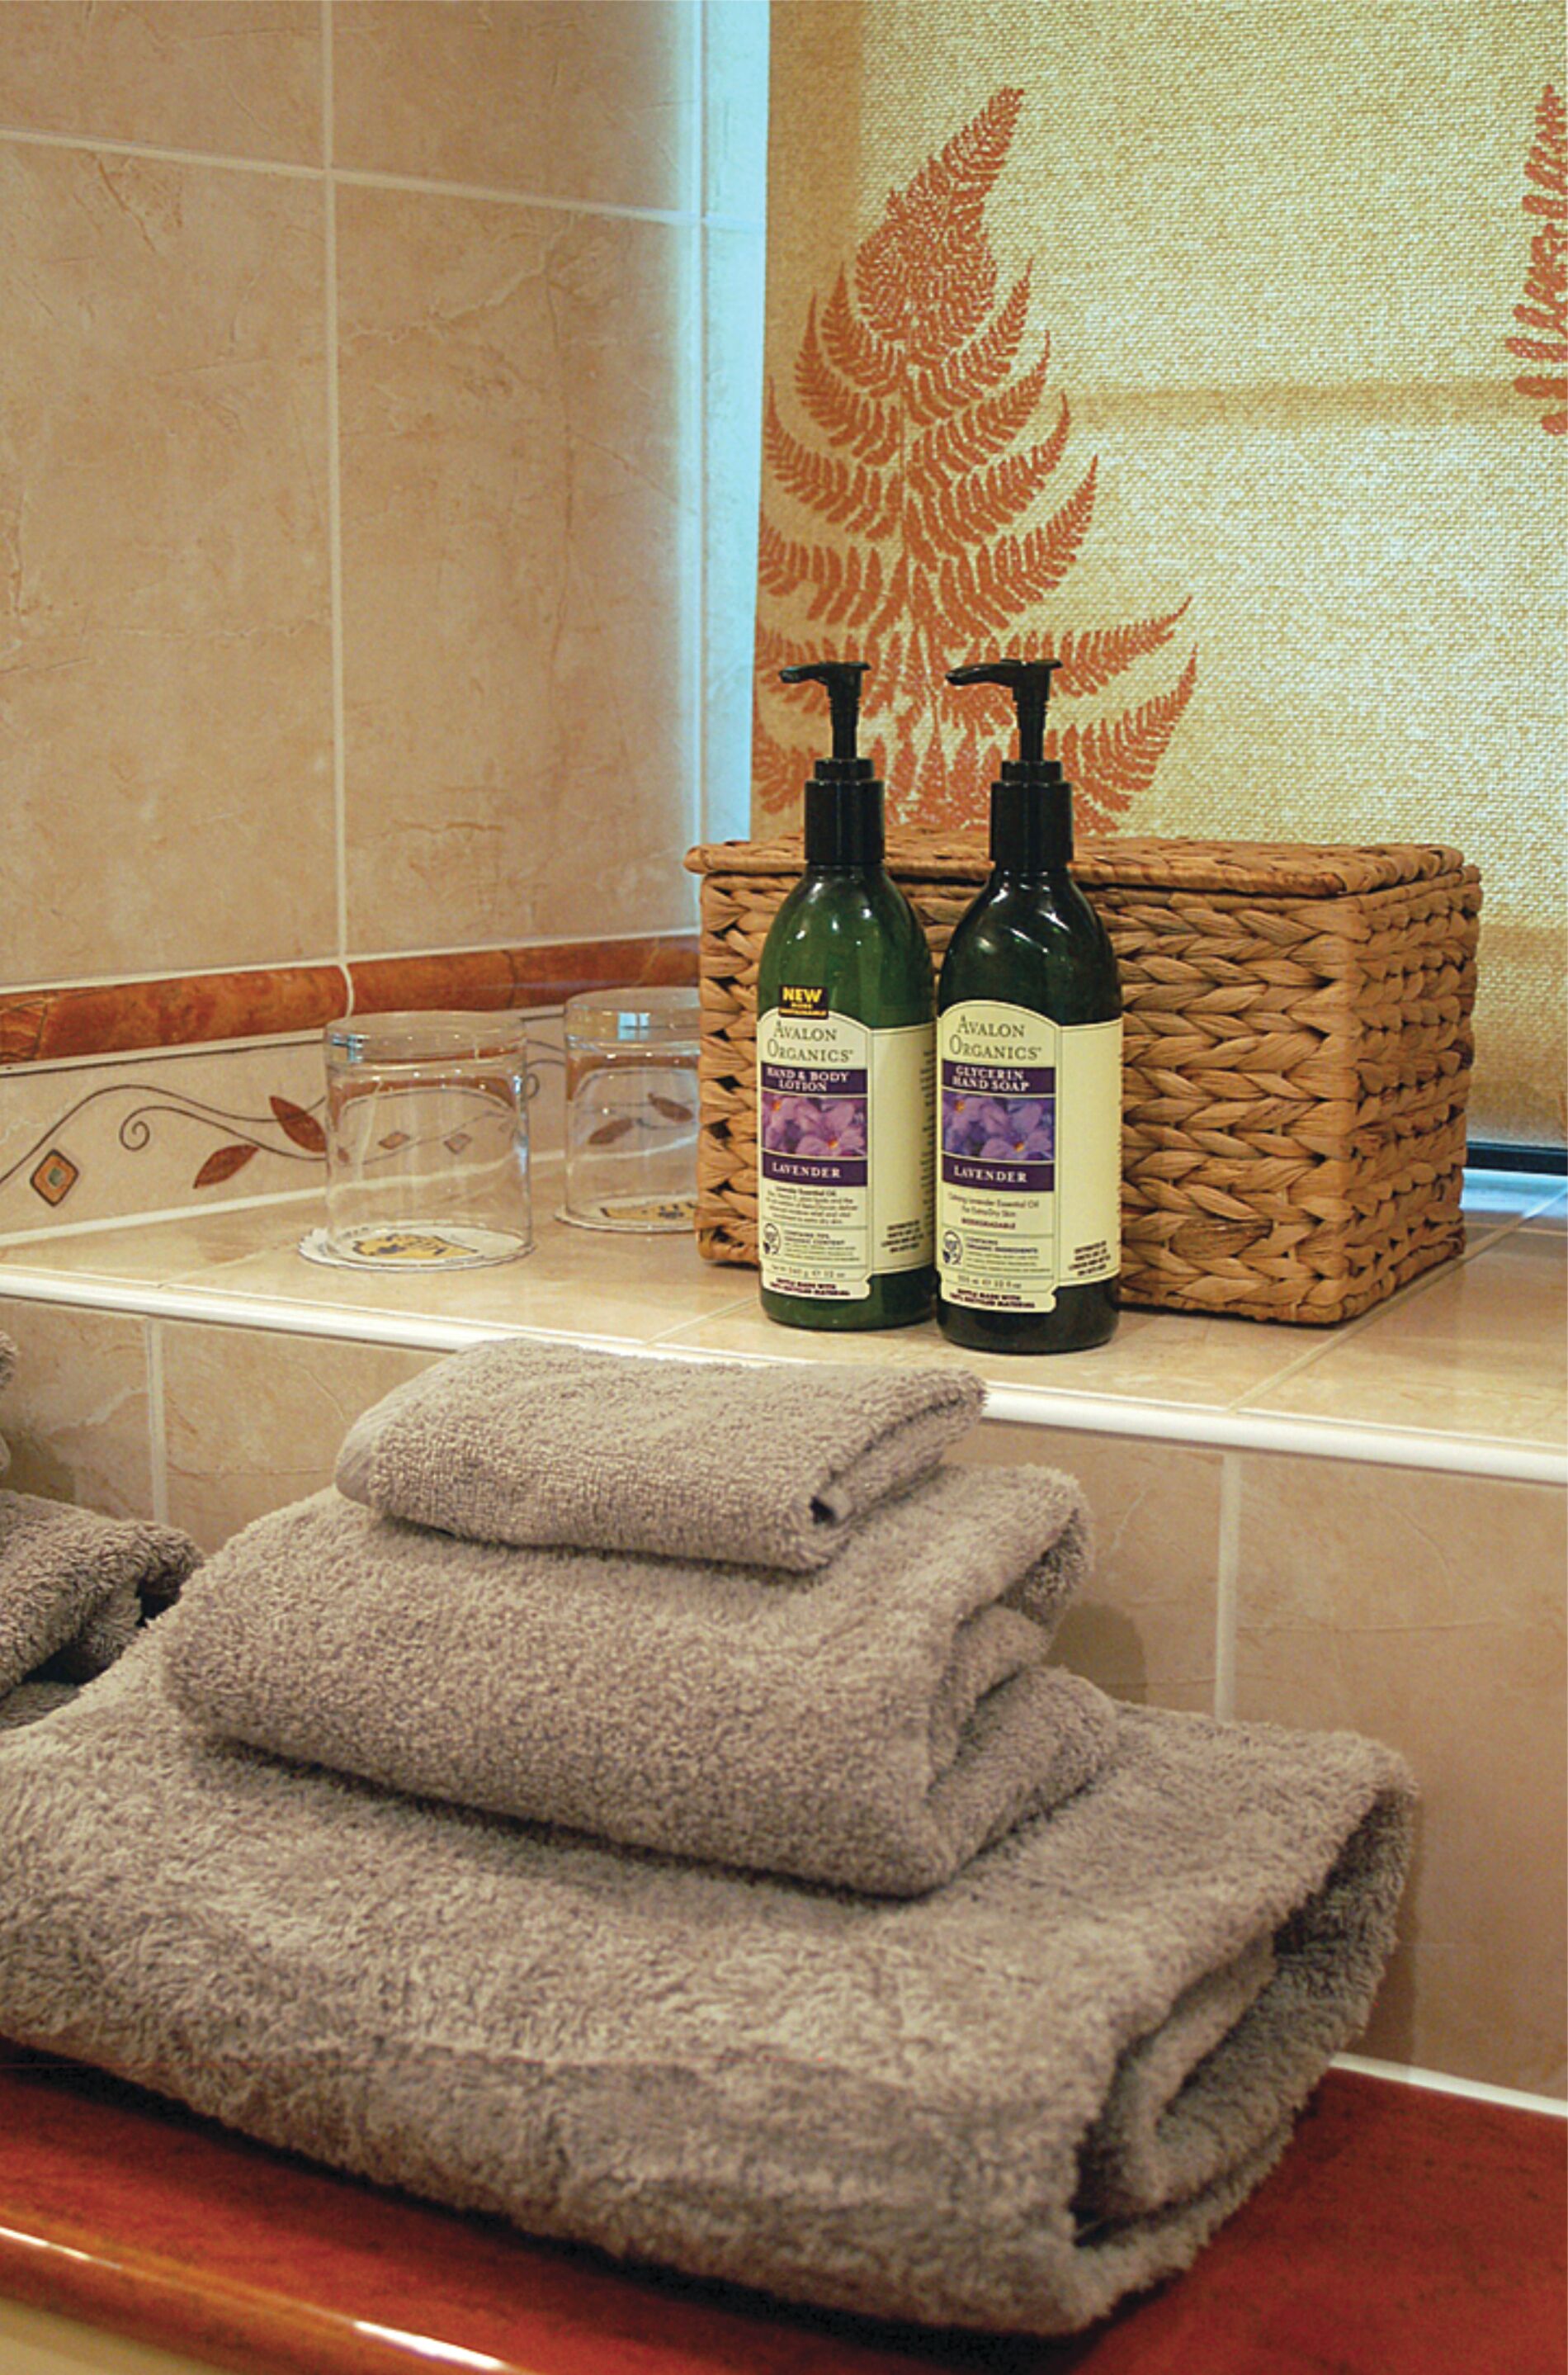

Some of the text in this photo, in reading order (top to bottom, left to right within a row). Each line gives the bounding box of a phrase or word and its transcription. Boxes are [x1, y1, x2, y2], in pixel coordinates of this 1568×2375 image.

[782, 986, 823, 1003] NEW
[773, 1020, 838, 1041] AVALON
[956, 1015, 1025, 1038] AVALON
[767, 1038, 850, 1063] ORGANICS
[949, 1034, 1038, 1061] ORGANICS
[767, 1067, 796, 1080] HAND
[810, 1071, 850, 1082] BODY
[955, 1065, 1024, 1081] GLYCERIN
[778, 1079, 827, 1092] LOTION
[952, 1075, 1031, 1092] HAND SOAP
[772, 1162, 841, 1179] LAVENDER
[954, 1165, 1028, 1184] LAVENDER
